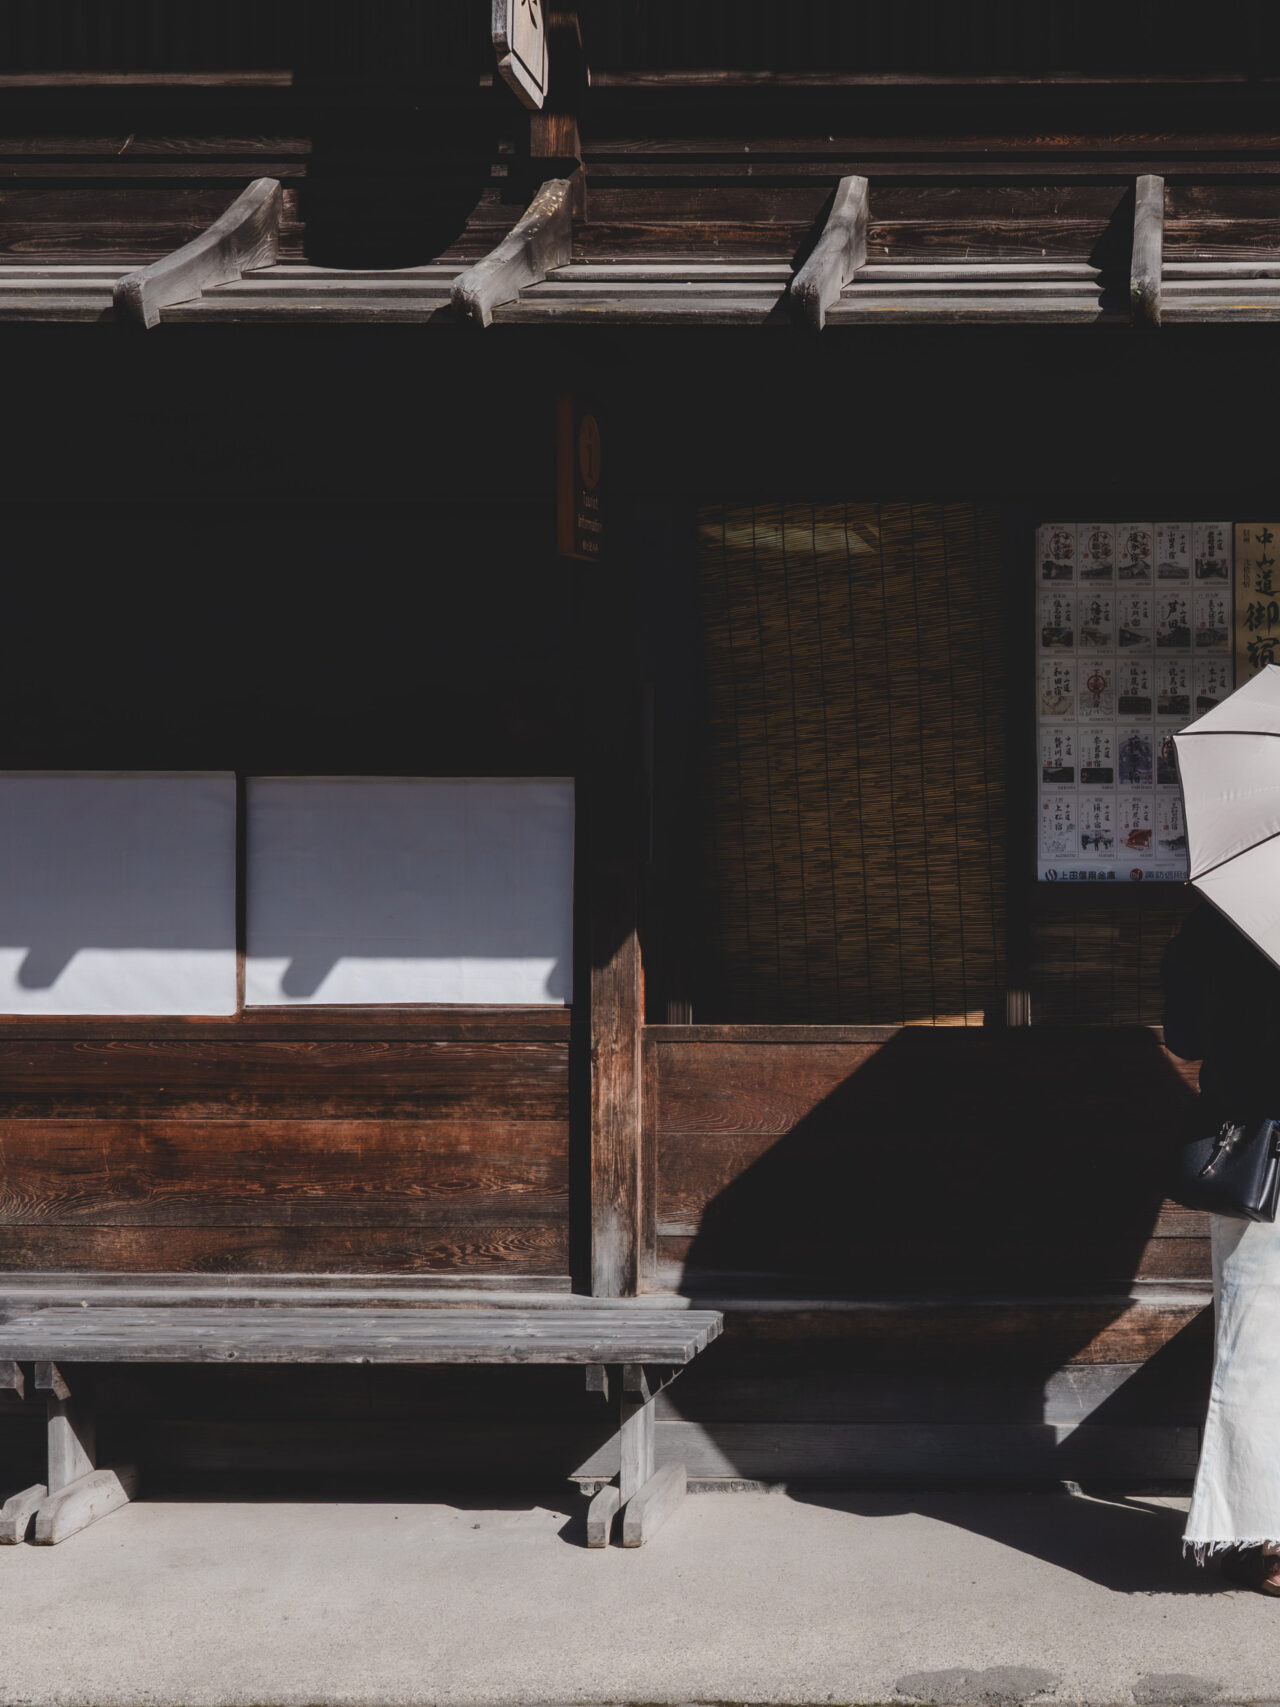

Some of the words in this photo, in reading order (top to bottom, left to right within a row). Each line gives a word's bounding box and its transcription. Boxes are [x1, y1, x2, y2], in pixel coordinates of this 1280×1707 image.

[1242, 527, 1280, 677] 中山道御宿
[1061, 871, 1116, 880] 上田信用金庫
